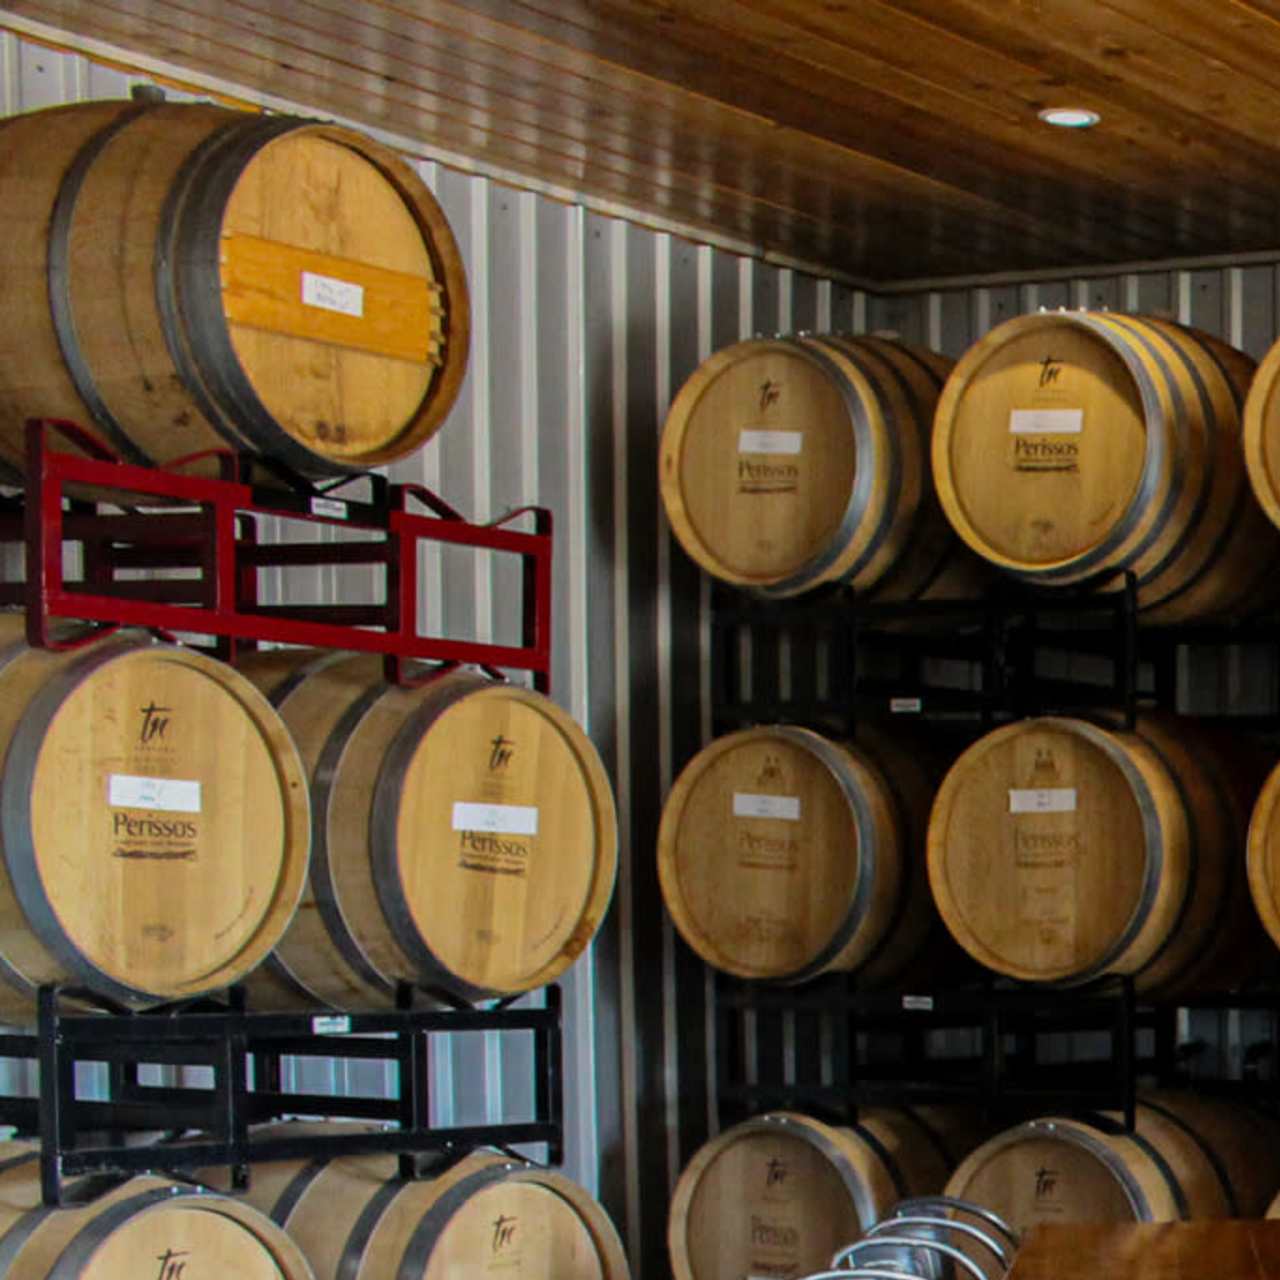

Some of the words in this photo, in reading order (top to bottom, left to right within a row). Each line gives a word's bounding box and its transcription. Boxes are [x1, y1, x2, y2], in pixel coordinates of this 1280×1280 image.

[1014, 437, 1079, 457] Perissos
[113, 812, 197, 838] Perissos
[461, 830, 528, 856] Perissos
